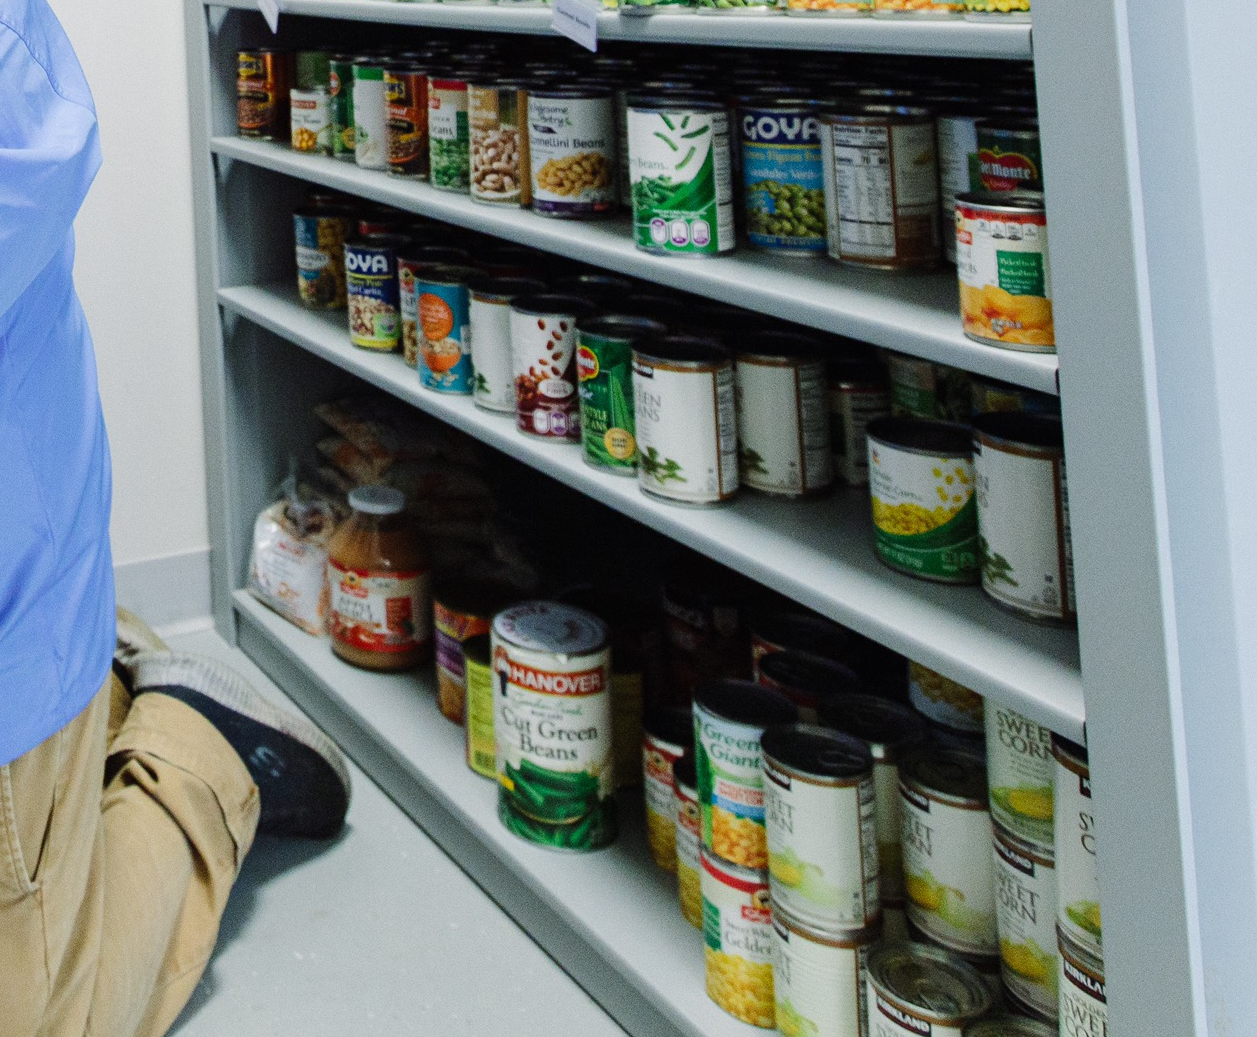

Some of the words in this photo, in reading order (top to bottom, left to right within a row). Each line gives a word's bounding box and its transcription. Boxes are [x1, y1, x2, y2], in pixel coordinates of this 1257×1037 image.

[573, 138, 605, 148] Beans
[992, 164, 1031, 180] Monte
[512, 665, 601, 694] HANOVER
[538, 720, 598, 742] Green
[702, 723, 761, 753] Green
[520, 733, 578, 760] Beans
[709, 742, 762, 769] Giant
